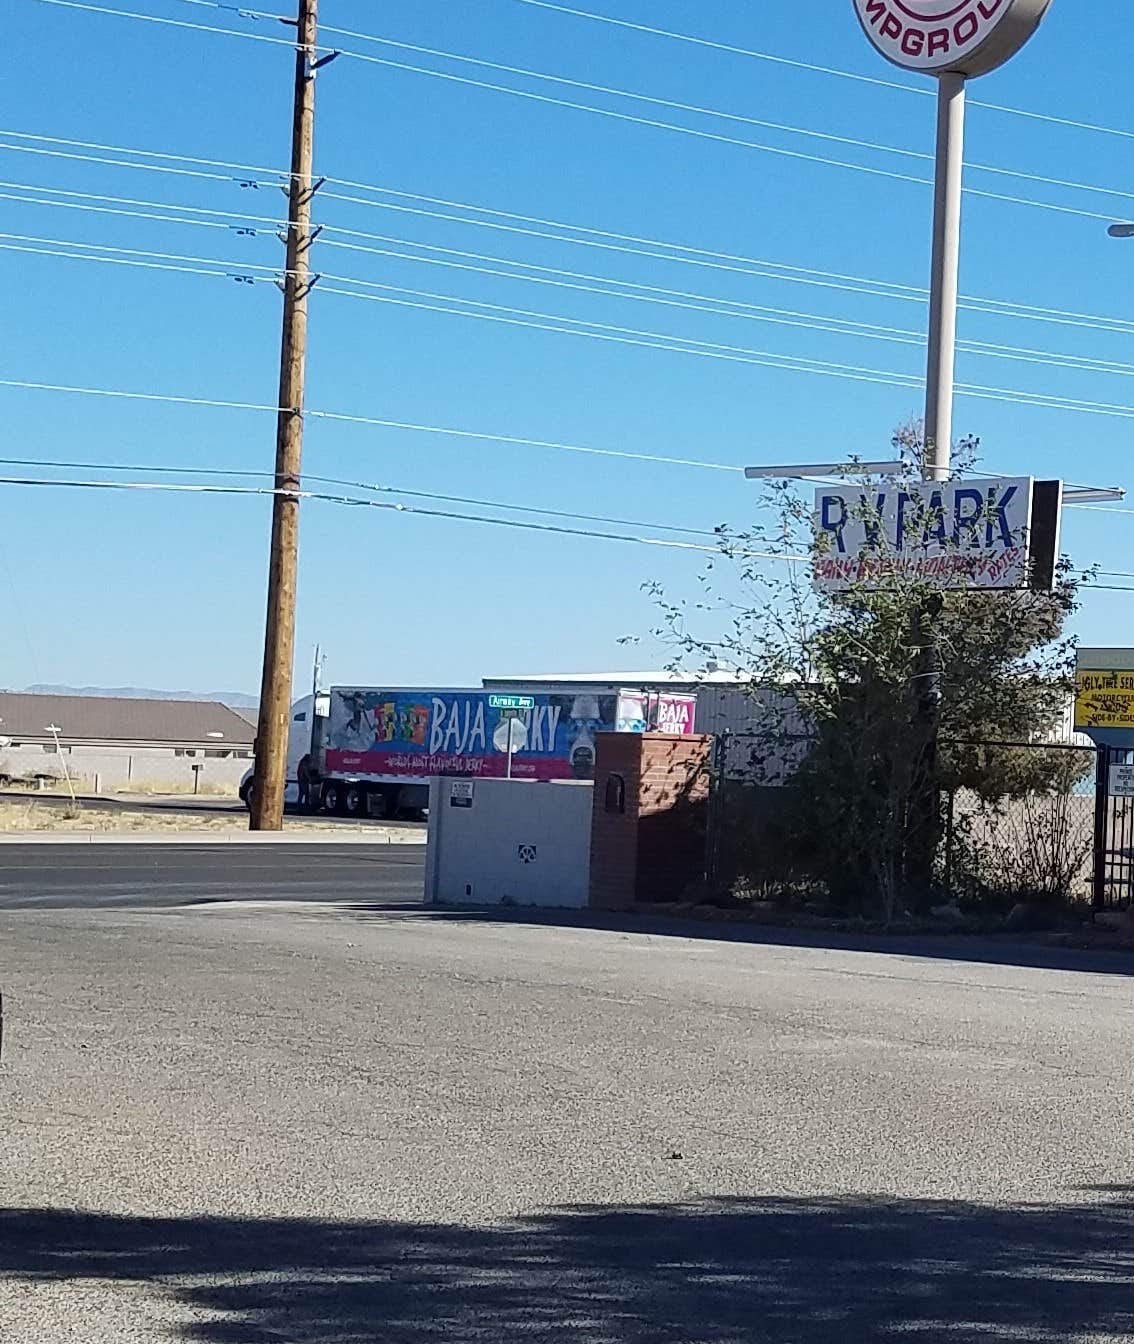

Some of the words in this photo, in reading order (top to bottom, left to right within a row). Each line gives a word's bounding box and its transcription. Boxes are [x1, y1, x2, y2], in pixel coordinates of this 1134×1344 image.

[895, 485, 1019, 552] PARK
[987, 546, 1019, 581] RATES
[429, 697, 486, 755] BAJA
[496, 705, 562, 752] RKY
[658, 702, 690, 723] BAJA
